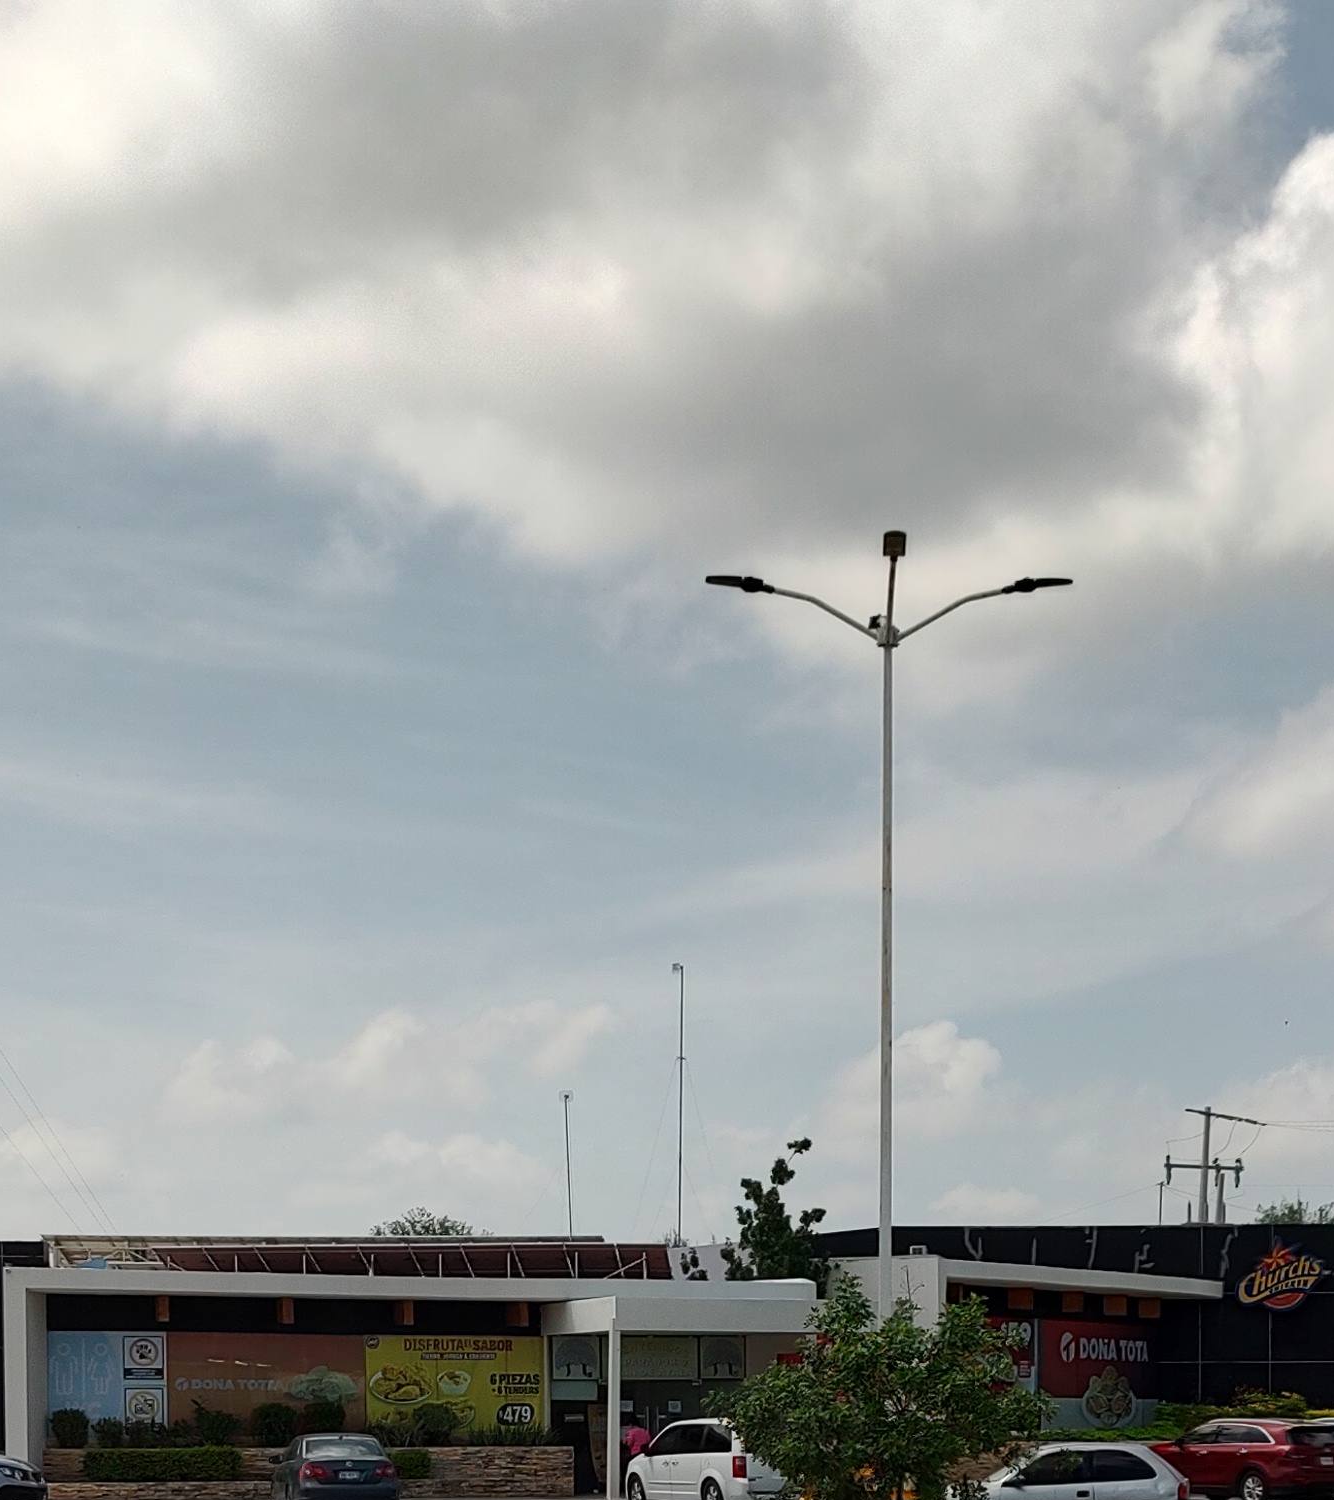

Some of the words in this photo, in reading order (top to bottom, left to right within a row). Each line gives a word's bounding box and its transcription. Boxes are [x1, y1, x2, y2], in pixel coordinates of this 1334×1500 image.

[1238, 1256, 1323, 1304] Church's
[403, 1338, 465, 1351] DISFRUTA
[472, 1339, 513, 1352] SABOR
[1119, 1339, 1149, 1362] TOTA
[498, 1373, 540, 1386] PIEZAS
